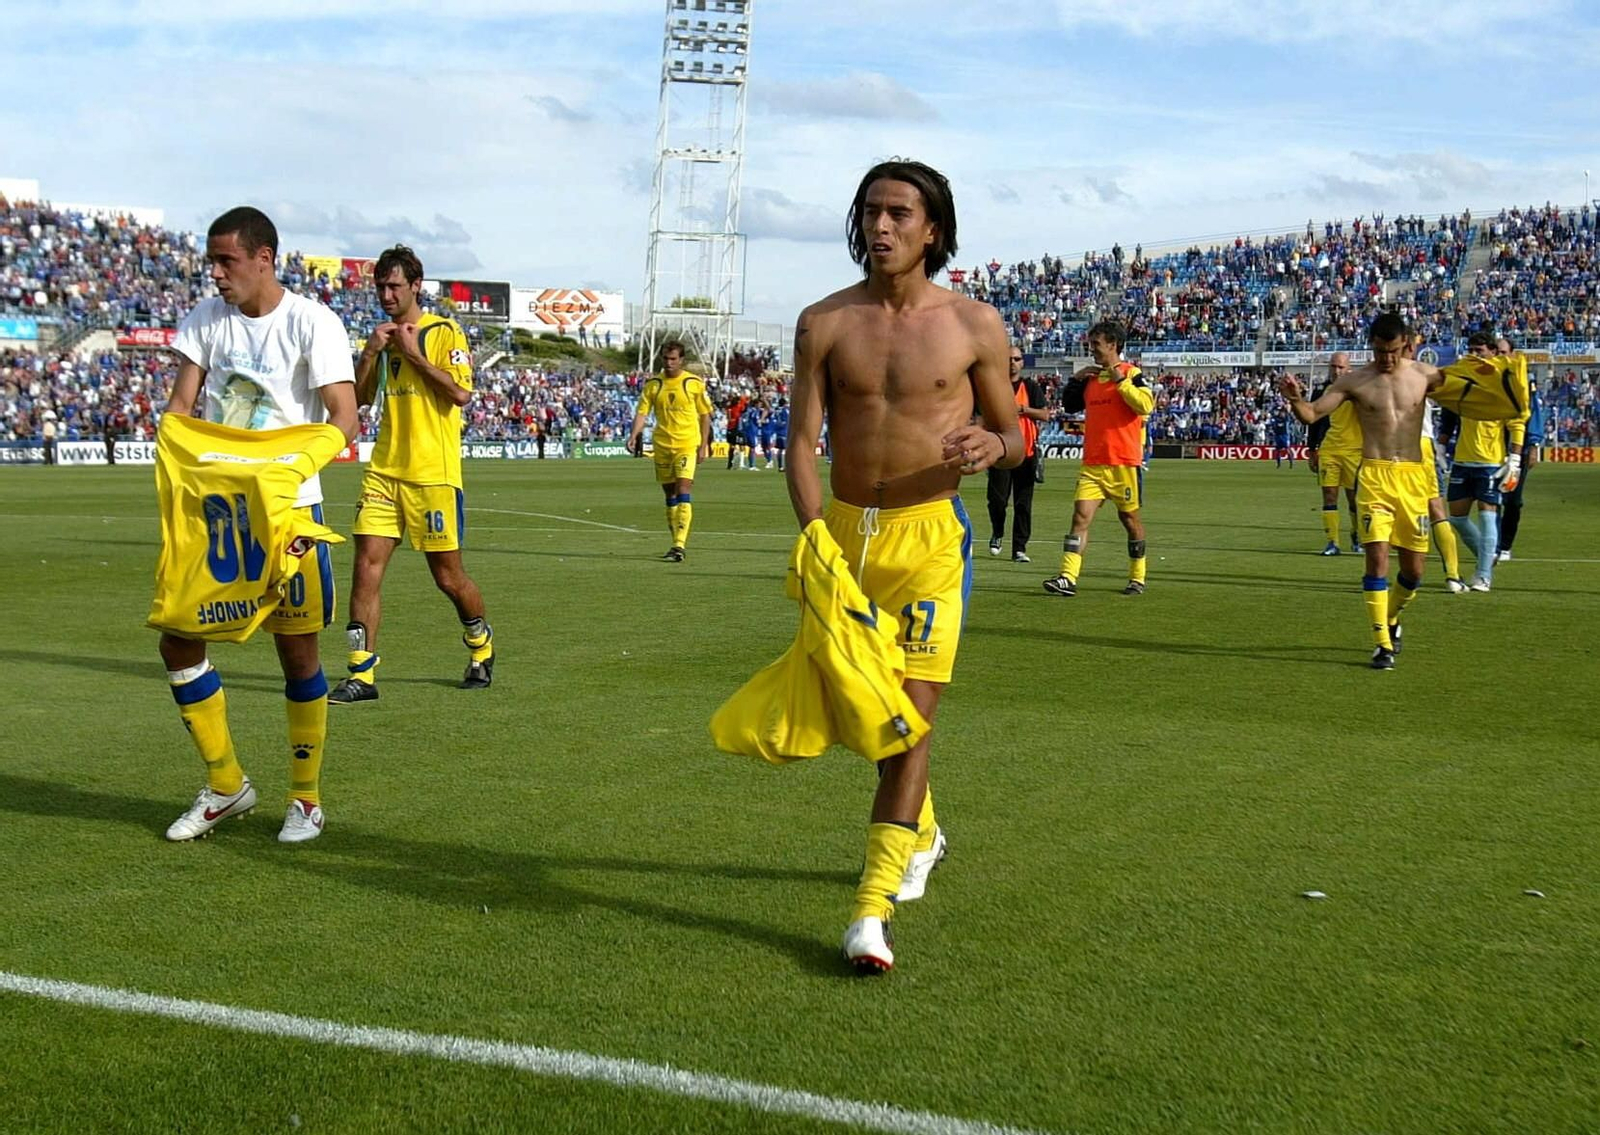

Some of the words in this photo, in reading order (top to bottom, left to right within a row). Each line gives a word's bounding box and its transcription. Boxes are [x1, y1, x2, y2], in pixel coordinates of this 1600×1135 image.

[528, 299, 606, 314] DIEZMA
[60, 446, 157, 460] wwwstste
[1040, 446, 1084, 459] Ya.co
[1201, 447, 1262, 460] NUEVO
[1550, 446, 1594, 463] 888
[1124, 487, 1132, 501] 9
[425, 510, 444, 533] 16
[901, 600, 936, 642] 17
